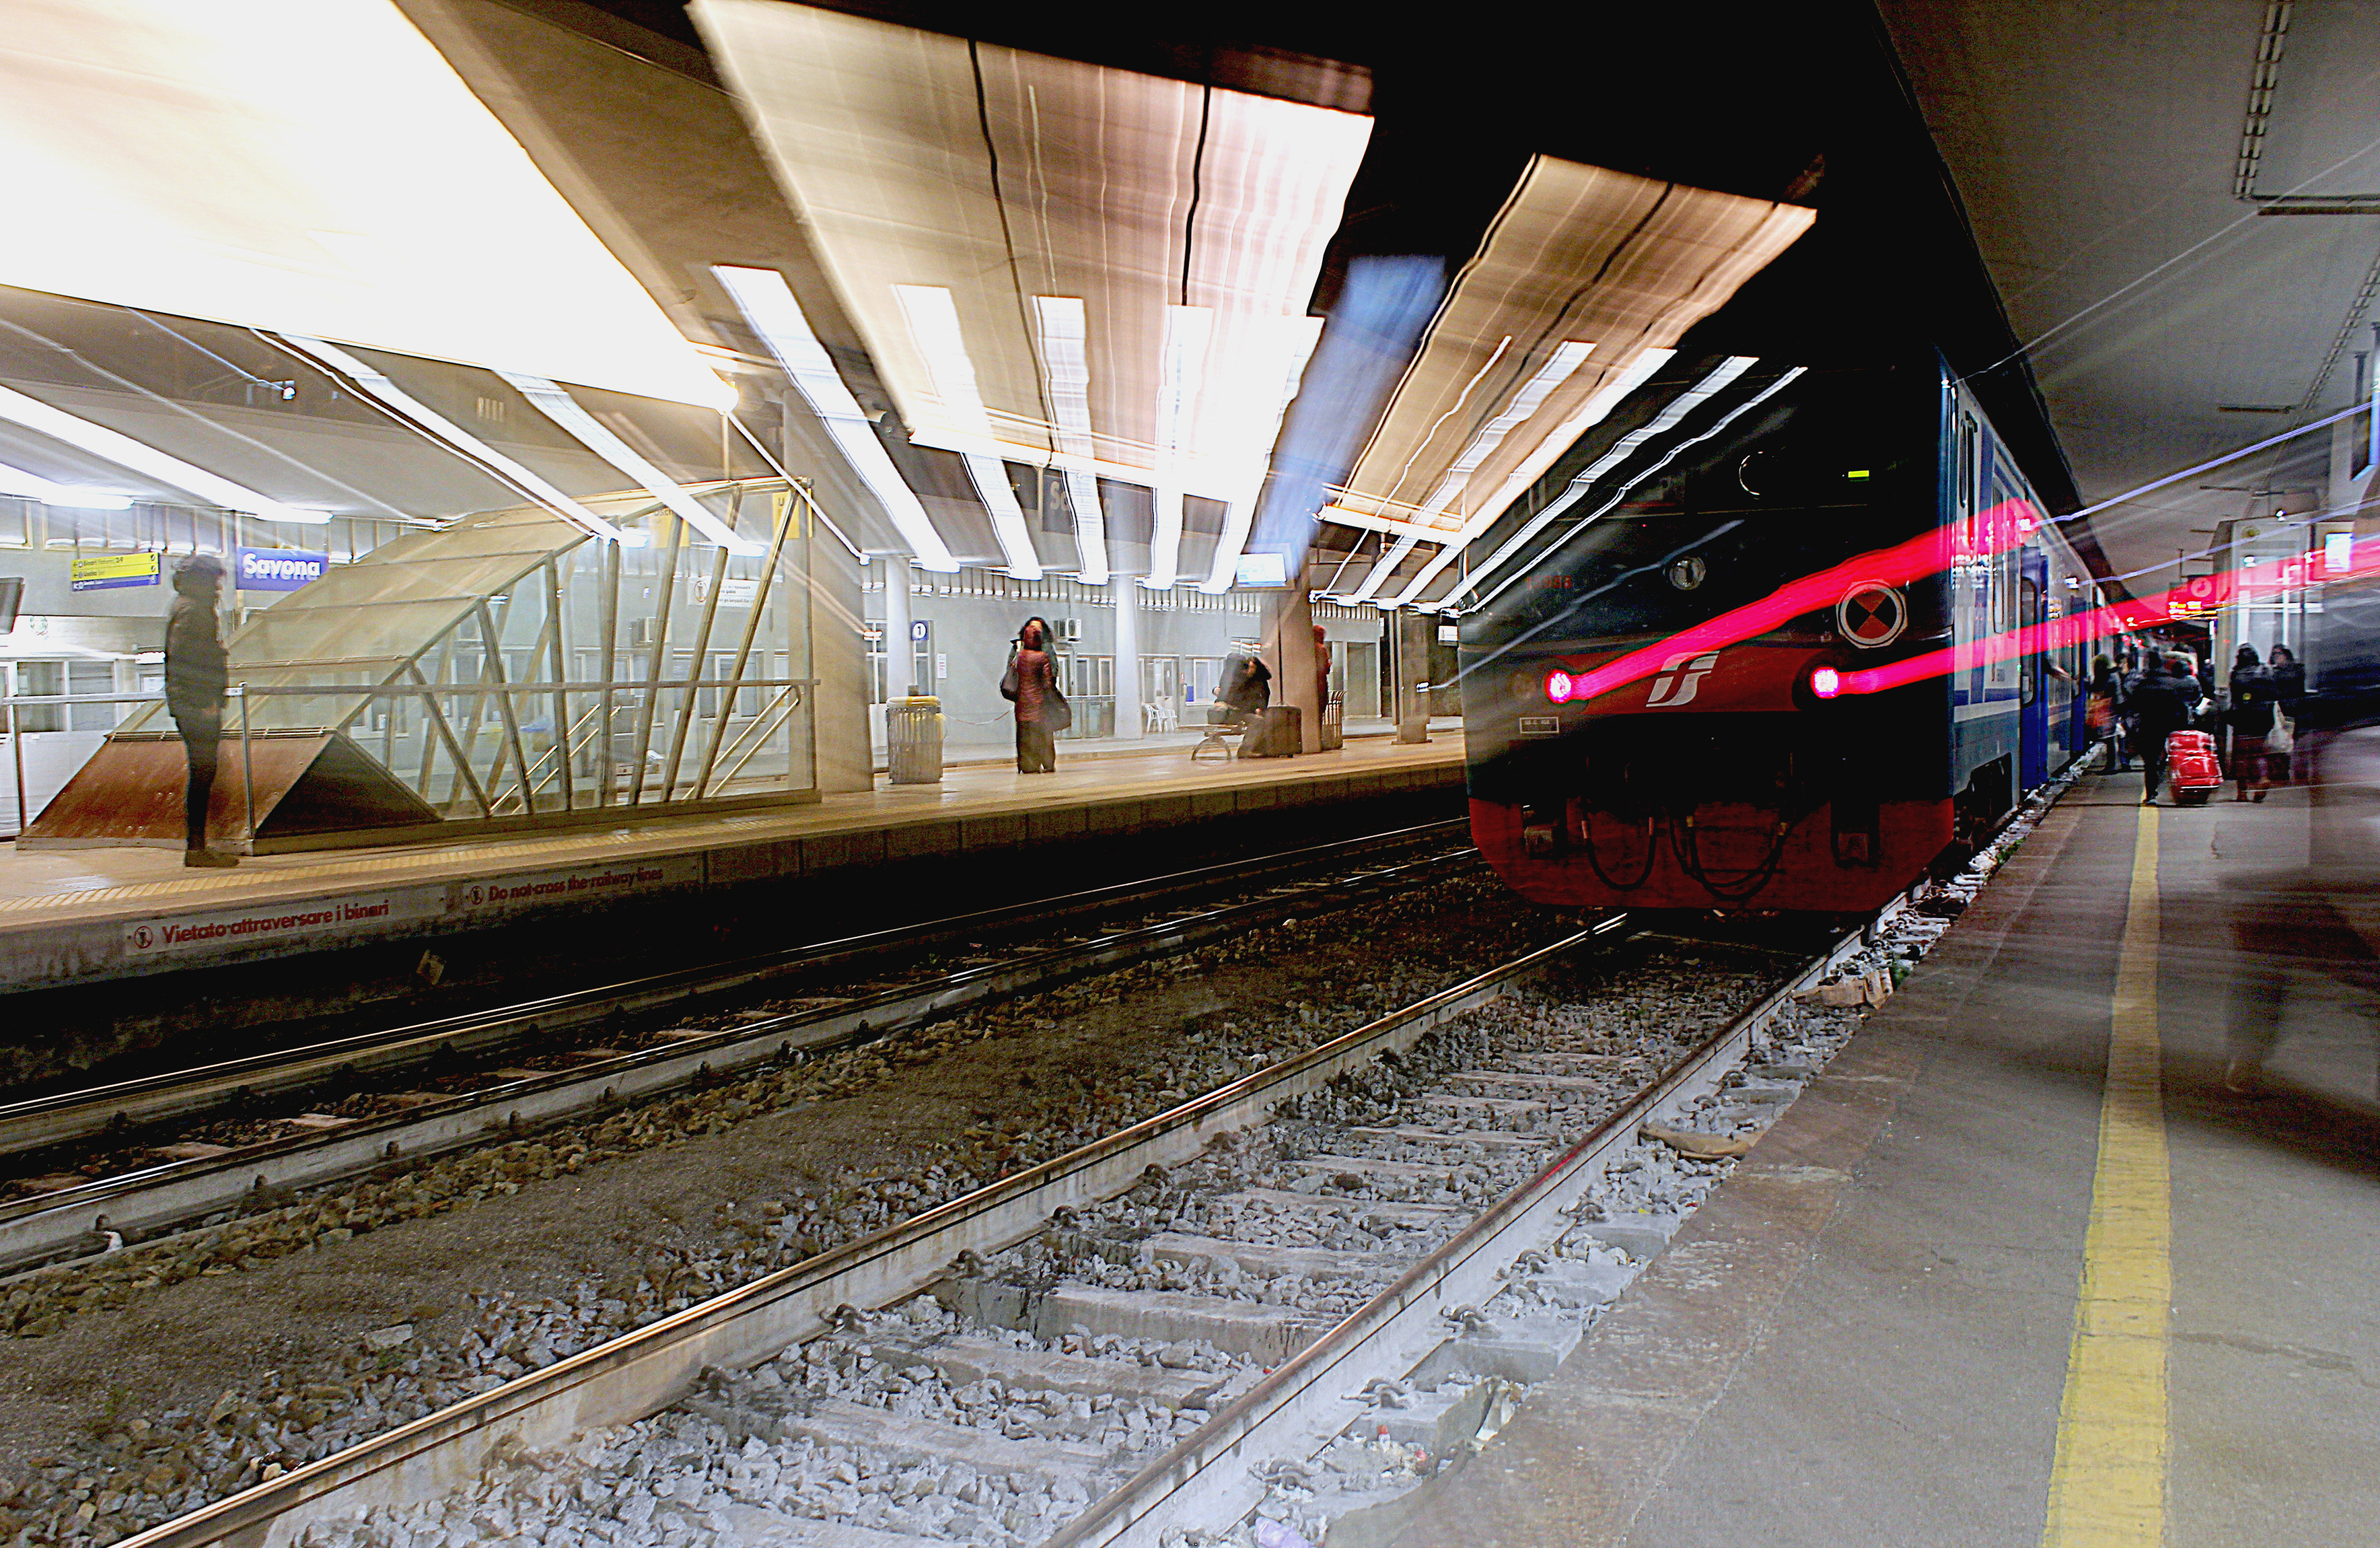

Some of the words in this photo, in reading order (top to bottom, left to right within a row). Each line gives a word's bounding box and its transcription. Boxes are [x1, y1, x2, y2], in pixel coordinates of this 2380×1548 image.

[243, 553, 321, 577] Savona
[489, 886, 508, 901] Do
[510, 882, 532, 899] not
[533, 880, 565, 895] cross
[568, 874, 588, 890] the
[591, 870, 634, 887] railway
[637, 866, 663, 882] lines
[161, 923, 227, 944] Vietato
[230, 910, 334, 935] attraversare
[336, 905, 342, 921] i
[345, 899, 390, 921] binari
